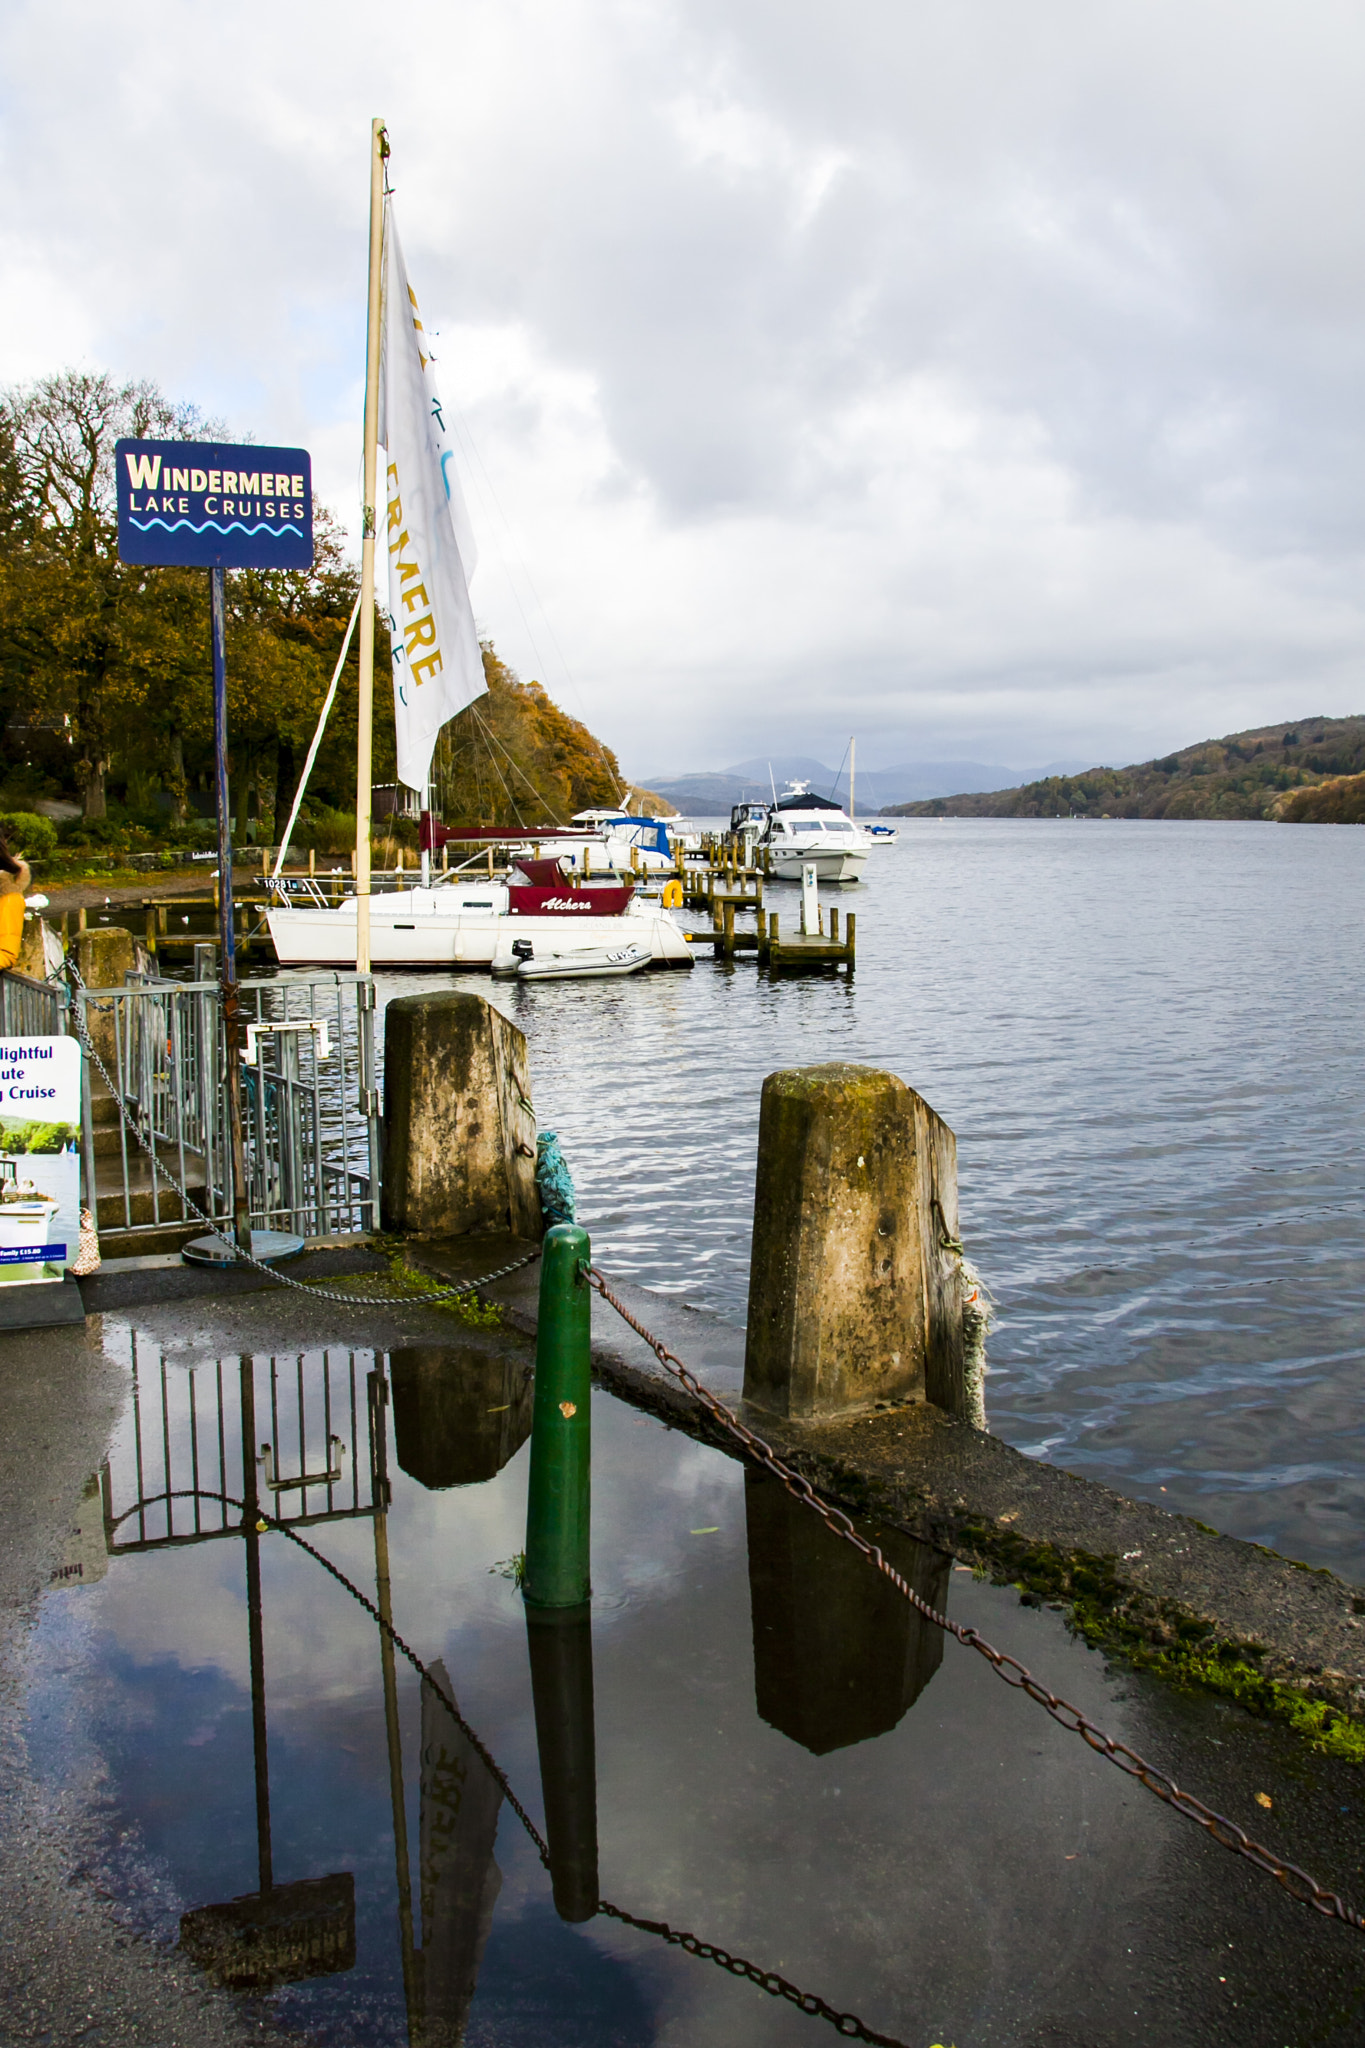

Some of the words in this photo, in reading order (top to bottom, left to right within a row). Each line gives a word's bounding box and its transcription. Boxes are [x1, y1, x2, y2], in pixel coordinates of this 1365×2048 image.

[125, 453, 305, 498] WINDERMERE
[129, 493, 190, 514] LAKE
[204, 496, 305, 519] CRUISES
[263, 879, 291, 889] 10281
[1, 1068, 25, 1080] ute
[8, 1085, 56, 1099] Cruise
